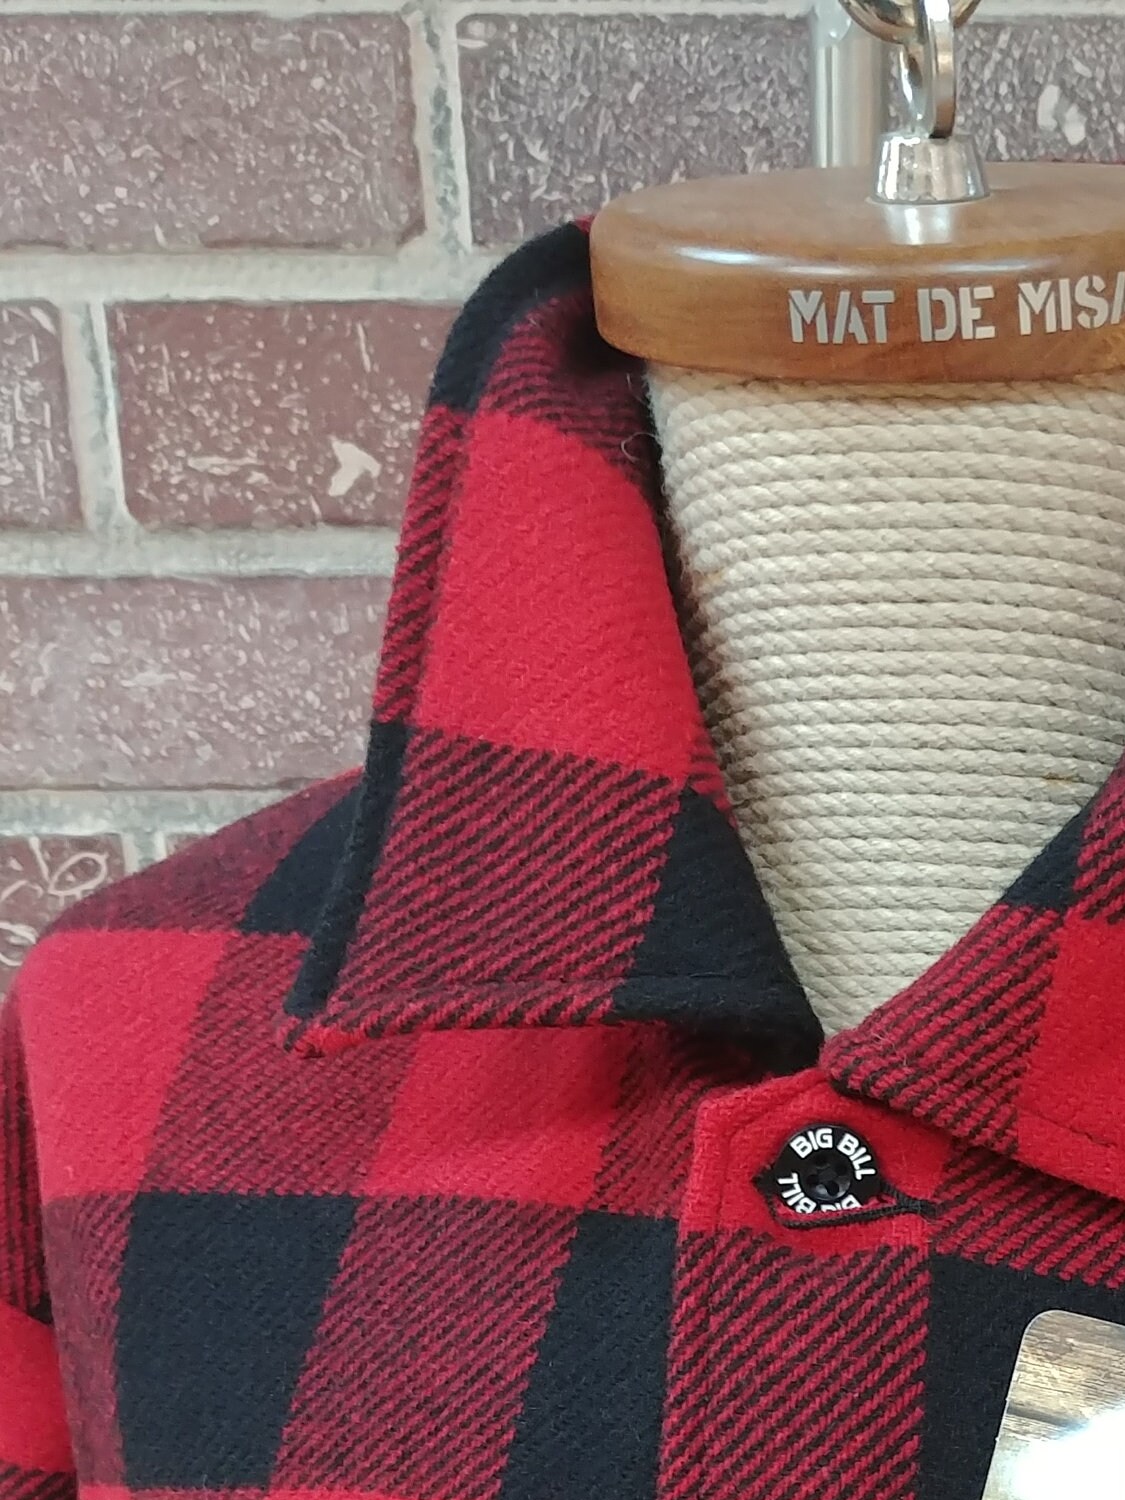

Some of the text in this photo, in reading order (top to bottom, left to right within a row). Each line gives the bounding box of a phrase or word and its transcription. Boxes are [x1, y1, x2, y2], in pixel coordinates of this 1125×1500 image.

[788, 290, 895, 345] MAT
[917, 286, 996, 342] DE
[790, 1128, 876, 1180] BIG BILL
